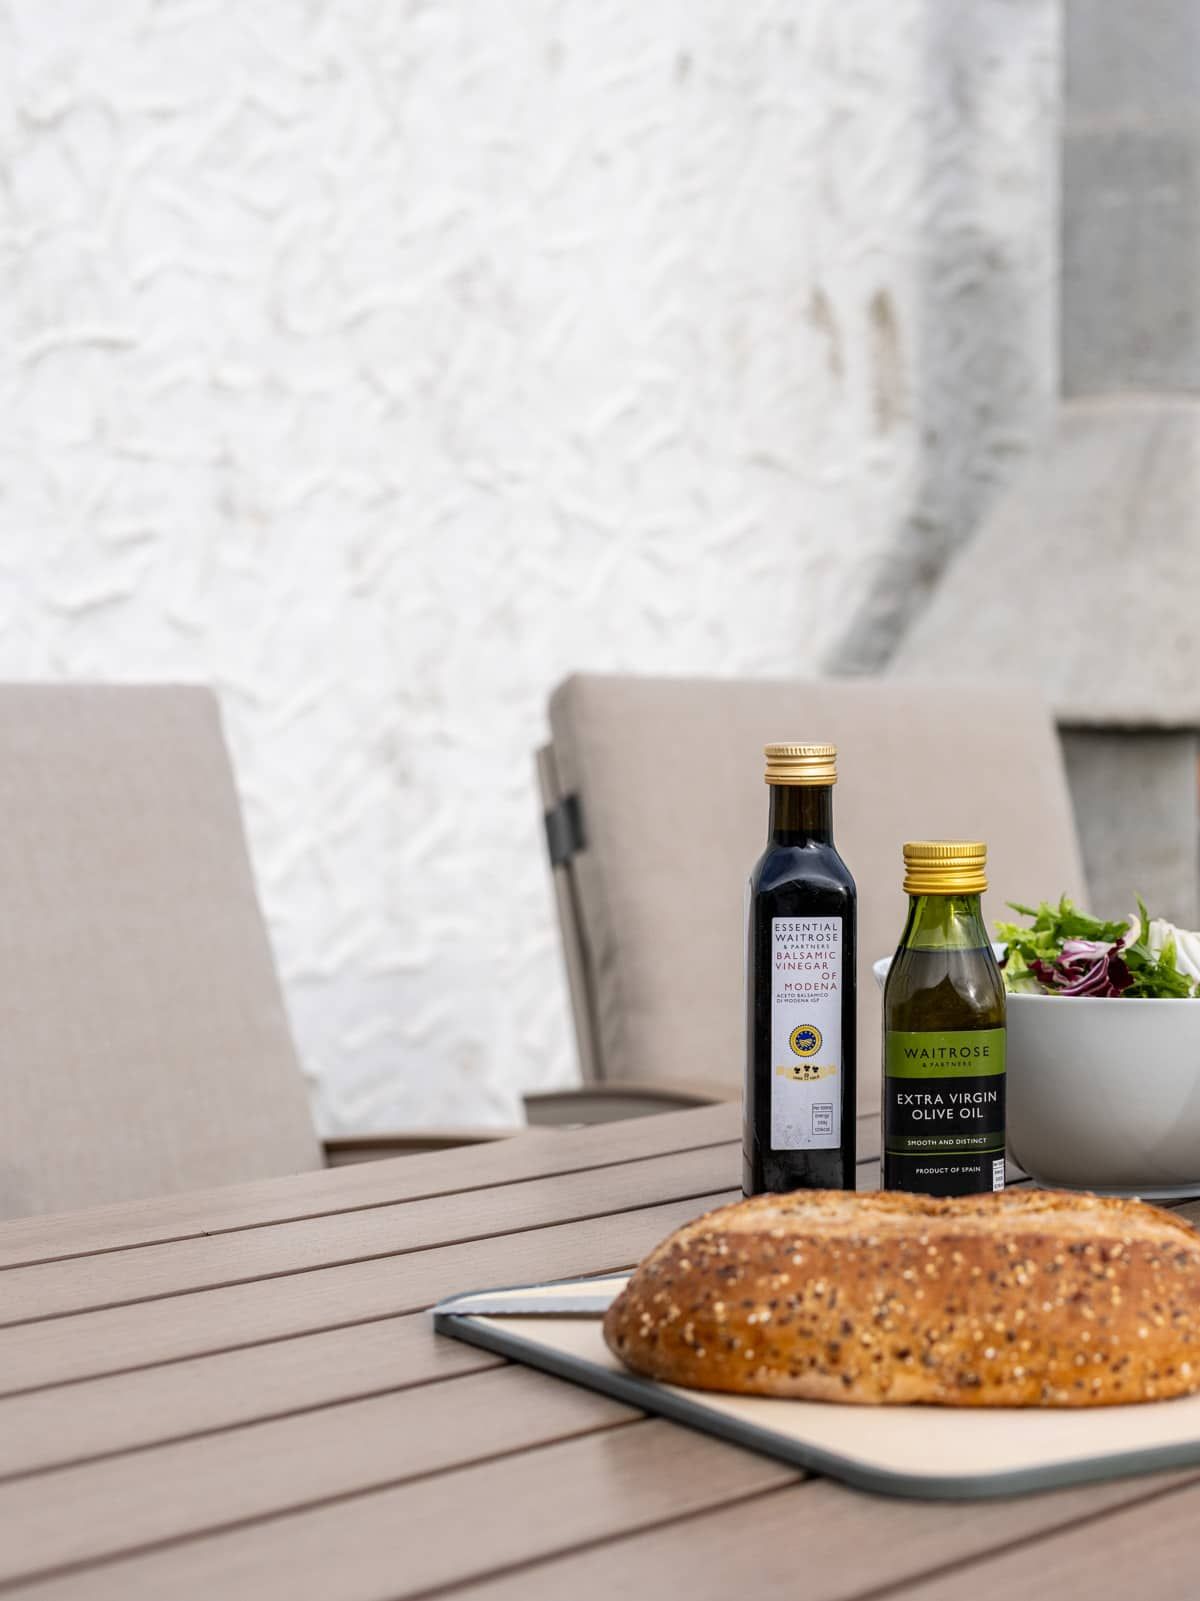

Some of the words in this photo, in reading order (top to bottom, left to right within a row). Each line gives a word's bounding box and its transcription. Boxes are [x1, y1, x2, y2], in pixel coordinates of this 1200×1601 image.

[775, 923, 838, 932] ESSENTIAL
[775, 933, 839, 942] WAITROSE
[776, 951, 836, 960] BALSAMIC
[775, 961, 829, 971] VINEGAR
[821, 971, 837, 980] OF
[784, 982, 838, 991] MODENA
[904, 1046, 990, 1059] WAITROSE
[930, 1060, 973, 1068] PARTNERS
[897, 1093, 944, 1105] EXTRA
[949, 1091, 998, 1104] VIRGIN
[911, 1108, 954, 1120] OLIVE
[959, 1107, 984, 1119] OIL
[955, 1137, 987, 1145] DISTINCT
